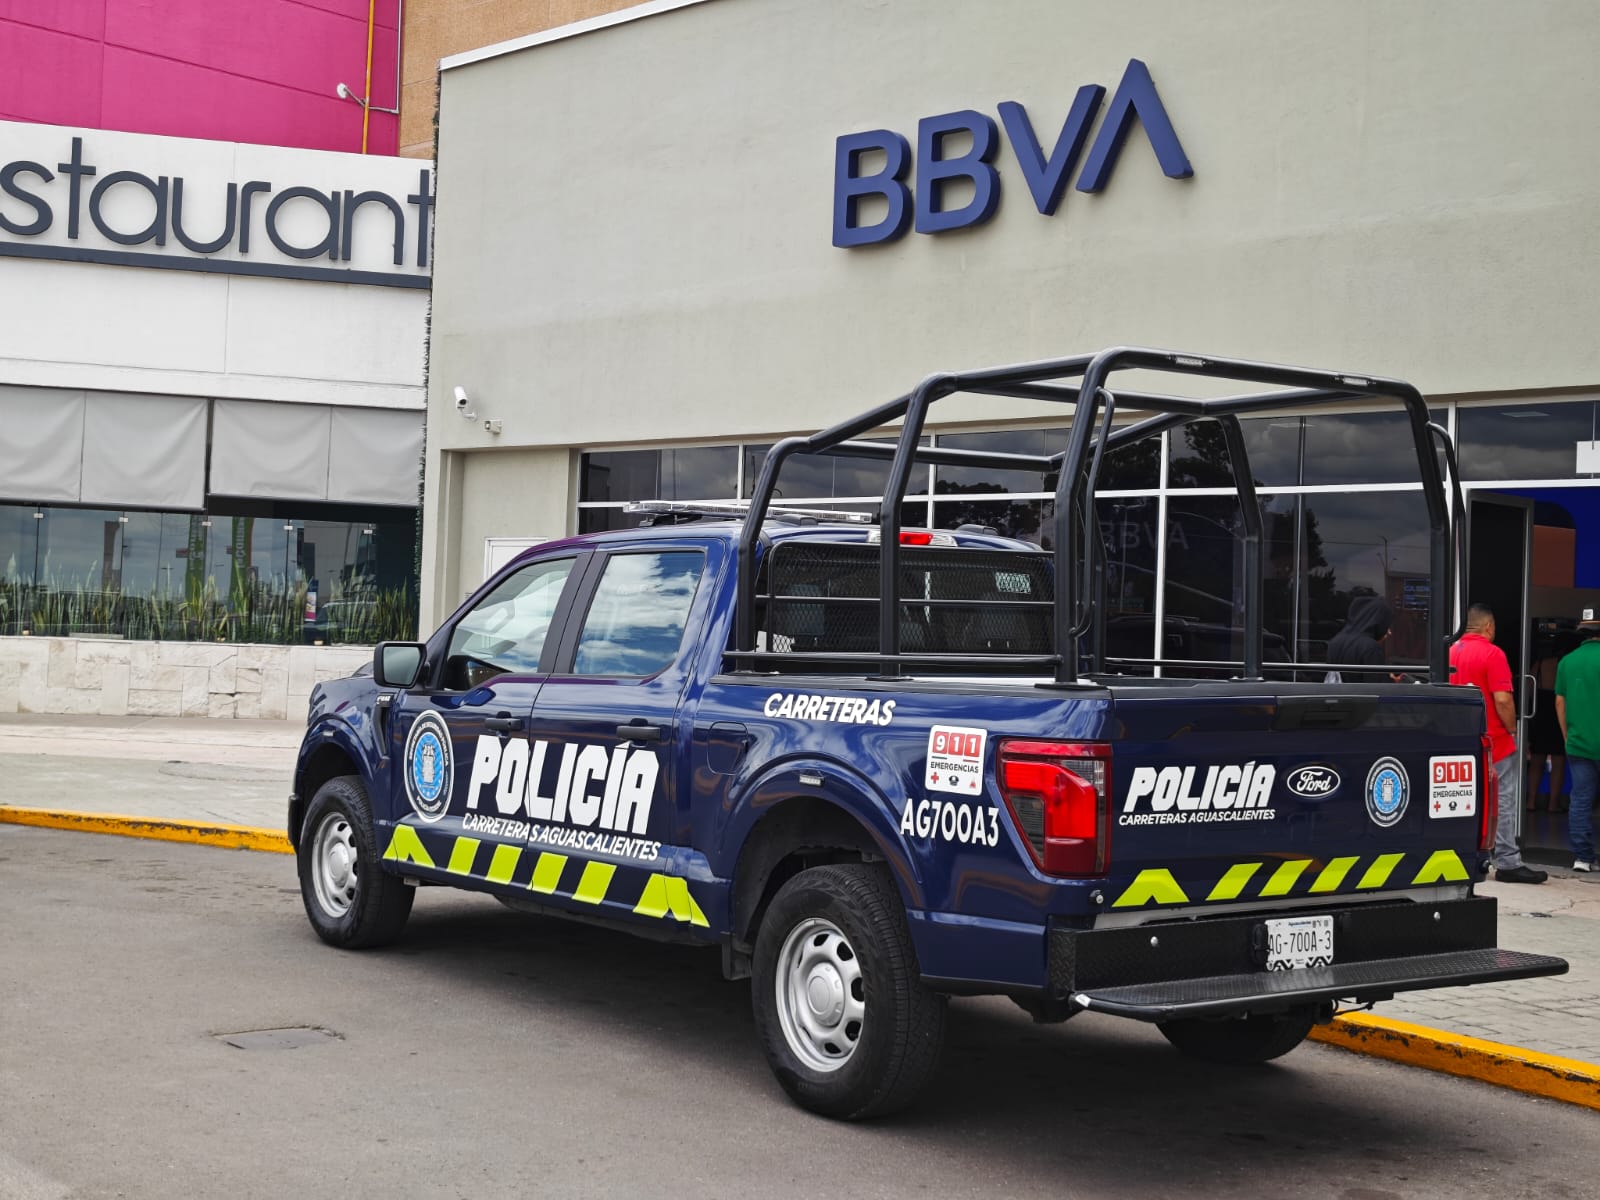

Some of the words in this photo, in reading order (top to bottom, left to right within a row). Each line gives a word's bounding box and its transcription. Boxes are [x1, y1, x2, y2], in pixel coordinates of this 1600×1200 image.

[832, 58, 1194, 248] BBVA
[764, 693, 896, 726] CARRETERAS
[935, 735, 977, 754] 911
[930, 761, 979, 774] EMERGENCIAS
[1296, 770, 1332, 791] Ford
[1436, 764, 1469, 781] 911
[466, 734, 660, 835] POLICÍA
[1123, 760, 1276, 812] POLICÍA
[1432, 789, 1473, 799] EMERGENCIAS
[900, 798, 999, 847] AG700A3
[1118, 812, 1188, 826] CARRETERAS
[1188, 809, 1276, 823] AGUASCALIENTES
[462, 813, 540, 842] CARRETERAS
[537, 825, 662, 861] AGUASCALIENTES
